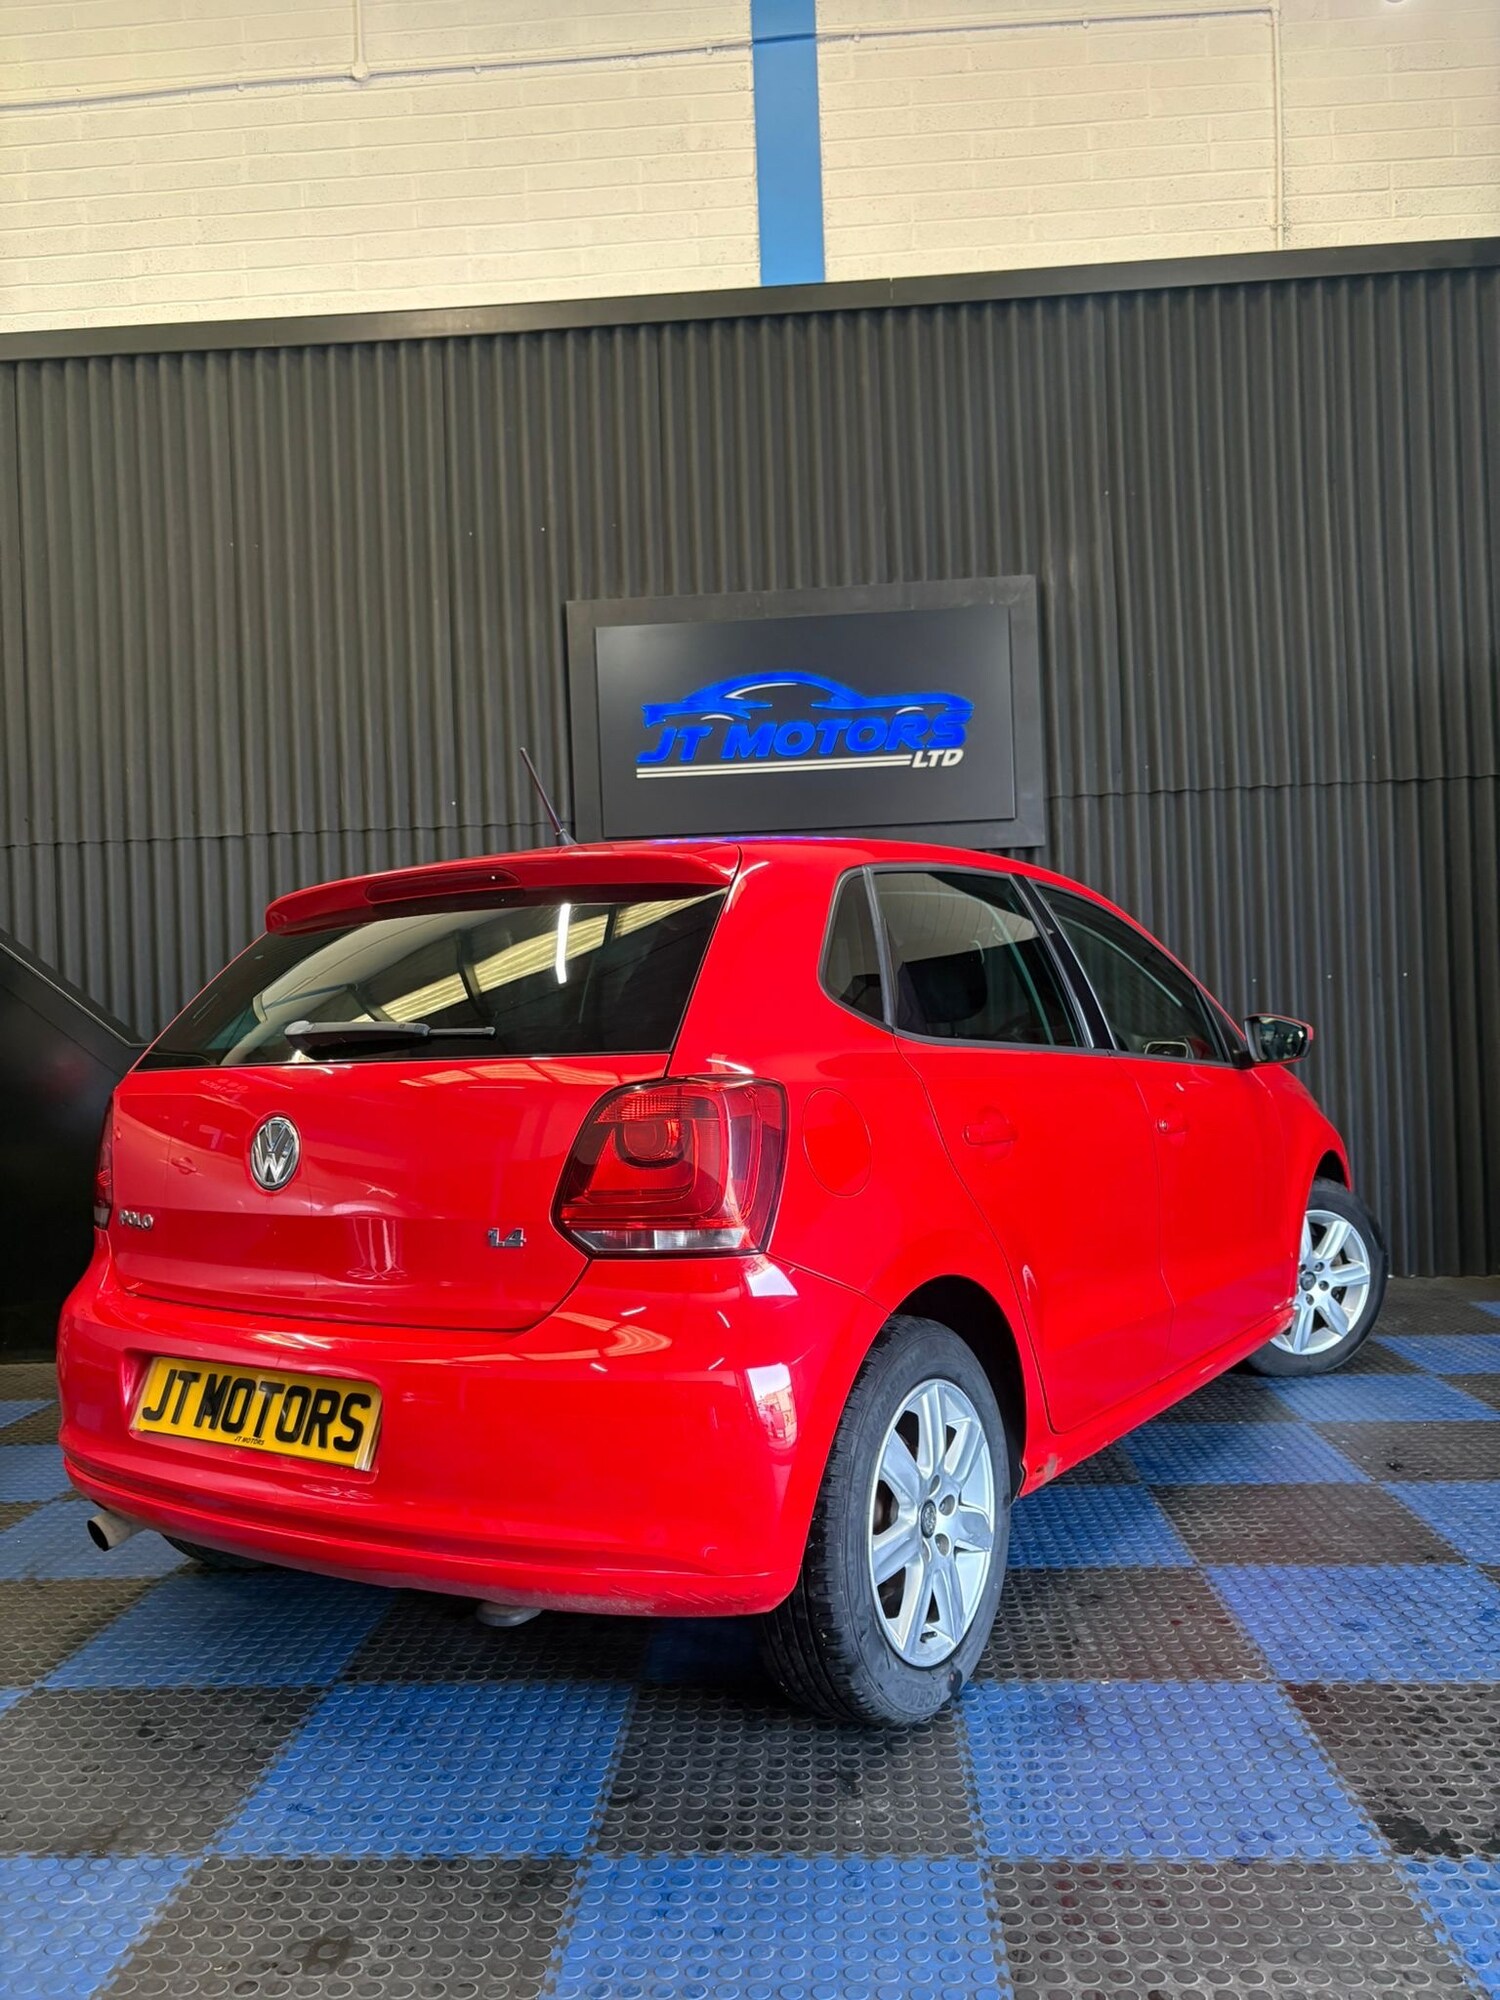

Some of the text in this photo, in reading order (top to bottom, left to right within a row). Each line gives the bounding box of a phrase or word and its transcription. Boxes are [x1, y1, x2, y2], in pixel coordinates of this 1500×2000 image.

[636, 712, 973, 764] JT MOTORS
[910, 748, 965, 768] LTD
[119, 1209, 154, 1231] POLO
[142, 1368, 371, 1452] JT MOTORS
[242, 1437, 265, 1446] MOTORS
